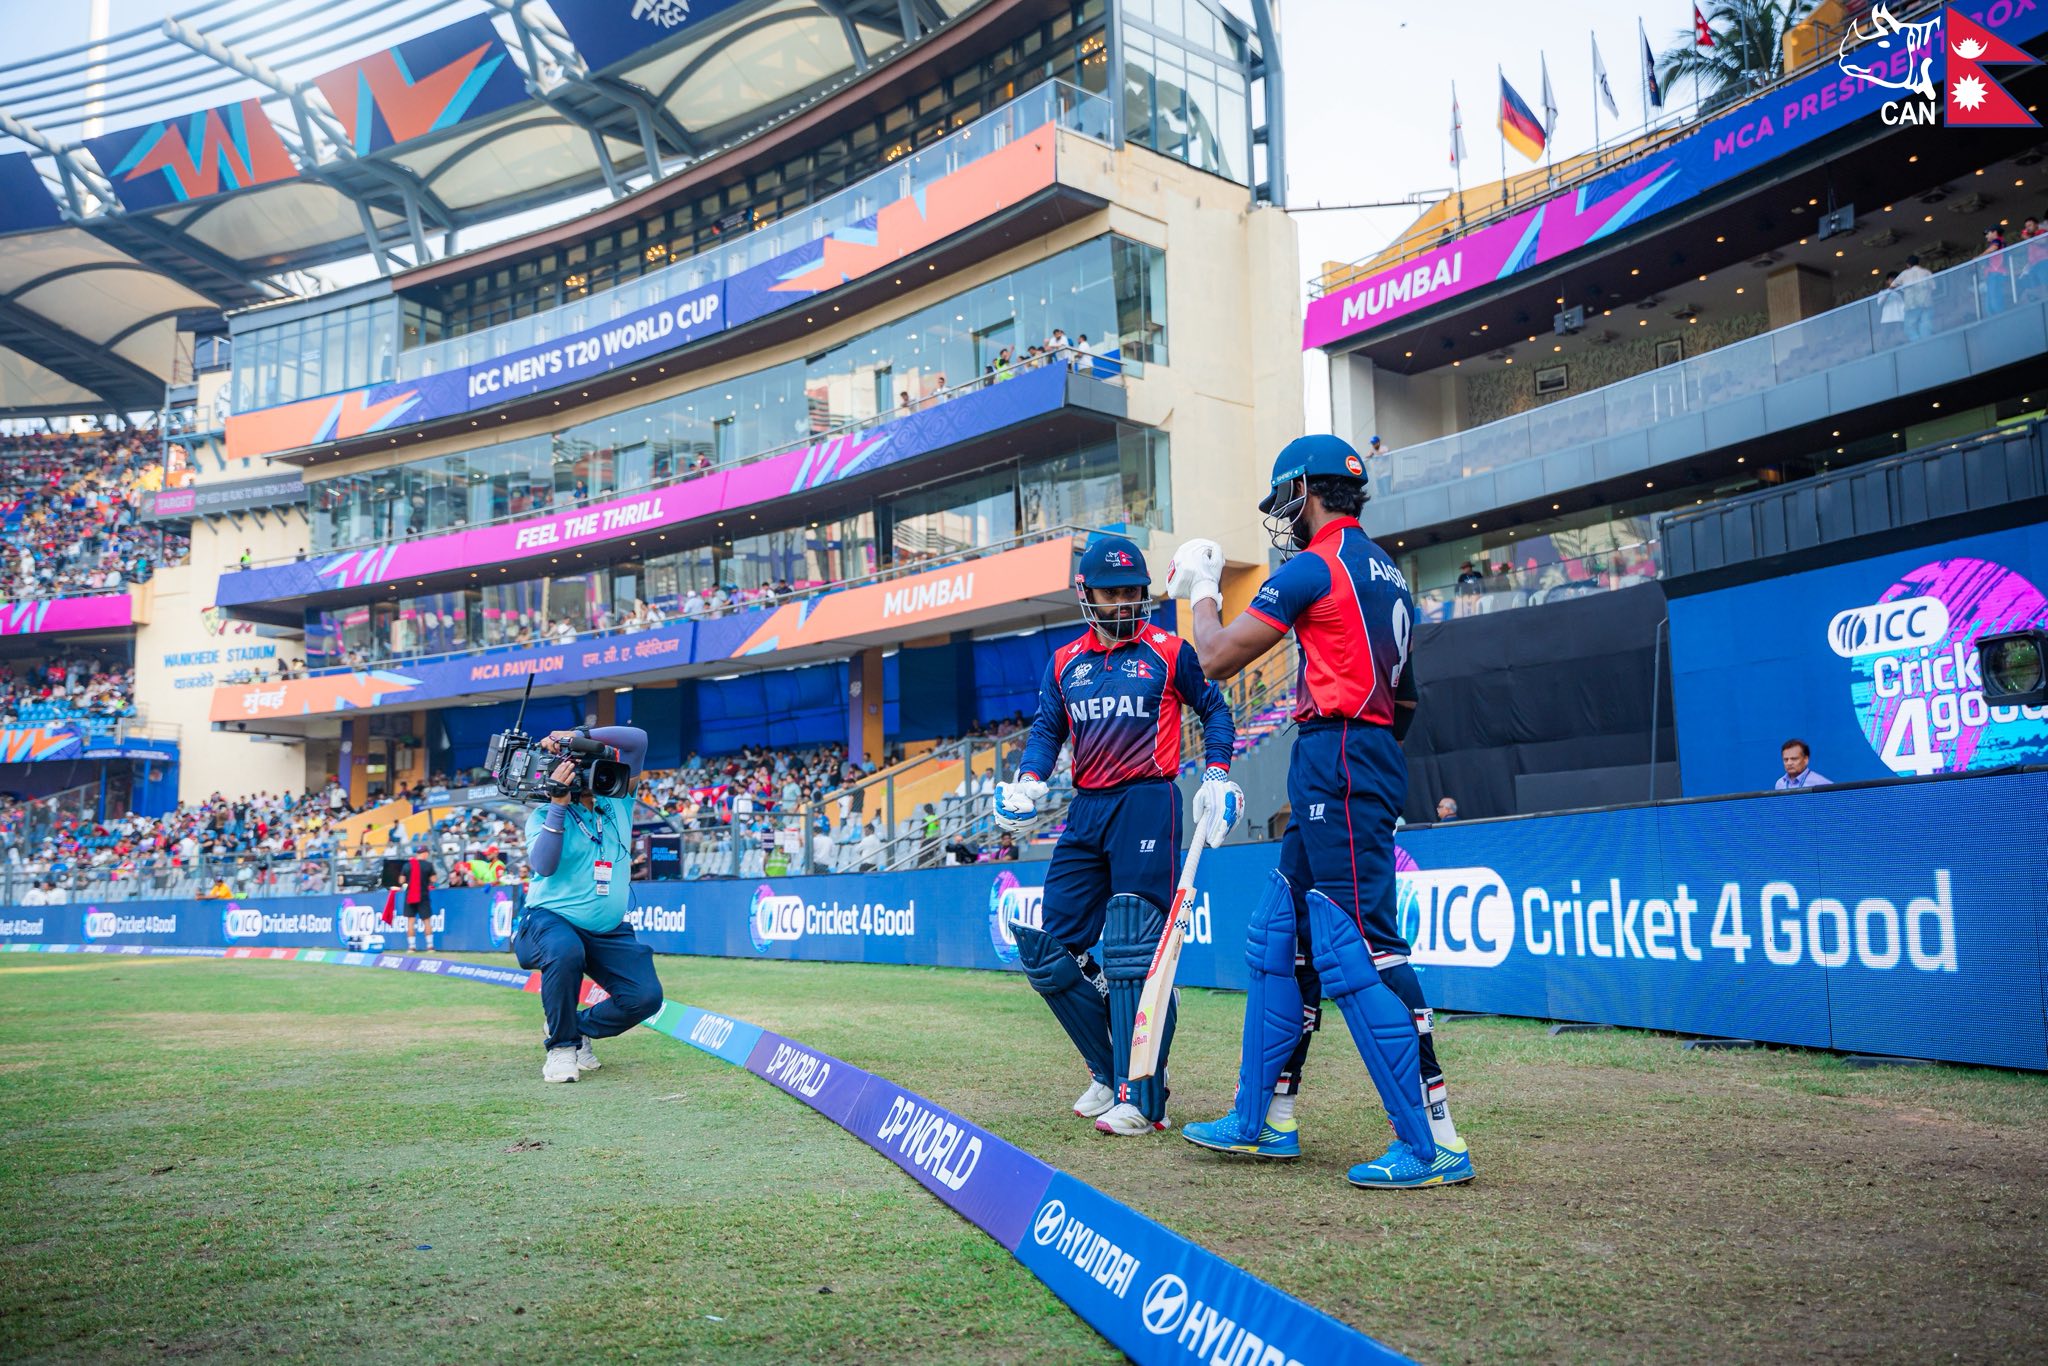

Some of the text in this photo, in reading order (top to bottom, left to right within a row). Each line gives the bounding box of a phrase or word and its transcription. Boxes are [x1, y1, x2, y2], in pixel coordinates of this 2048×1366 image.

[660, 7, 686, 28] ICC
[1713, 115, 1774, 161] MCA
[1342, 251, 1462, 327] MUMBAI
[468, 294, 719, 398] ICC MEN'S T20 WORLD CUP
[515, 498, 664, 550] FEEL THE THRILL
[882, 572, 975, 618] MUMBAI
[1874, 605, 1928, 643] ICC
[164, 645, 276, 668] WANKHEDE STADIUM
[471, 655, 564, 681] MCA PAVILION
[242, 685, 288, 714] मुंबई
[1070, 695, 1150, 723] NEPAL
[1880, 697, 1944, 776] 4
[468, 785, 499, 800] ENGLAND
[97, 917, 114, 933] ICC
[117, 915, 146, 934] Cricket
[152, 914, 176, 933] Good
[239, 913, 259, 932] ICC
[262, 913, 299, 933] Cricket
[299, 914, 307, 931] 4
[355, 910, 373, 931] ICC
[643, 906, 654, 932] 4
[654, 904, 686, 932] Good
[776, 900, 914, 936] ICC Cricket 4 Good
[1429, 868, 1958, 972] ICC Cricket 4 Good
[690, 1013, 734, 1050] aramco
[765, 1043, 831, 1098] DP WORLD
[877, 1095, 982, 1191] DP WORLD
[1056, 1217, 1141, 1299] HYUNDAI
